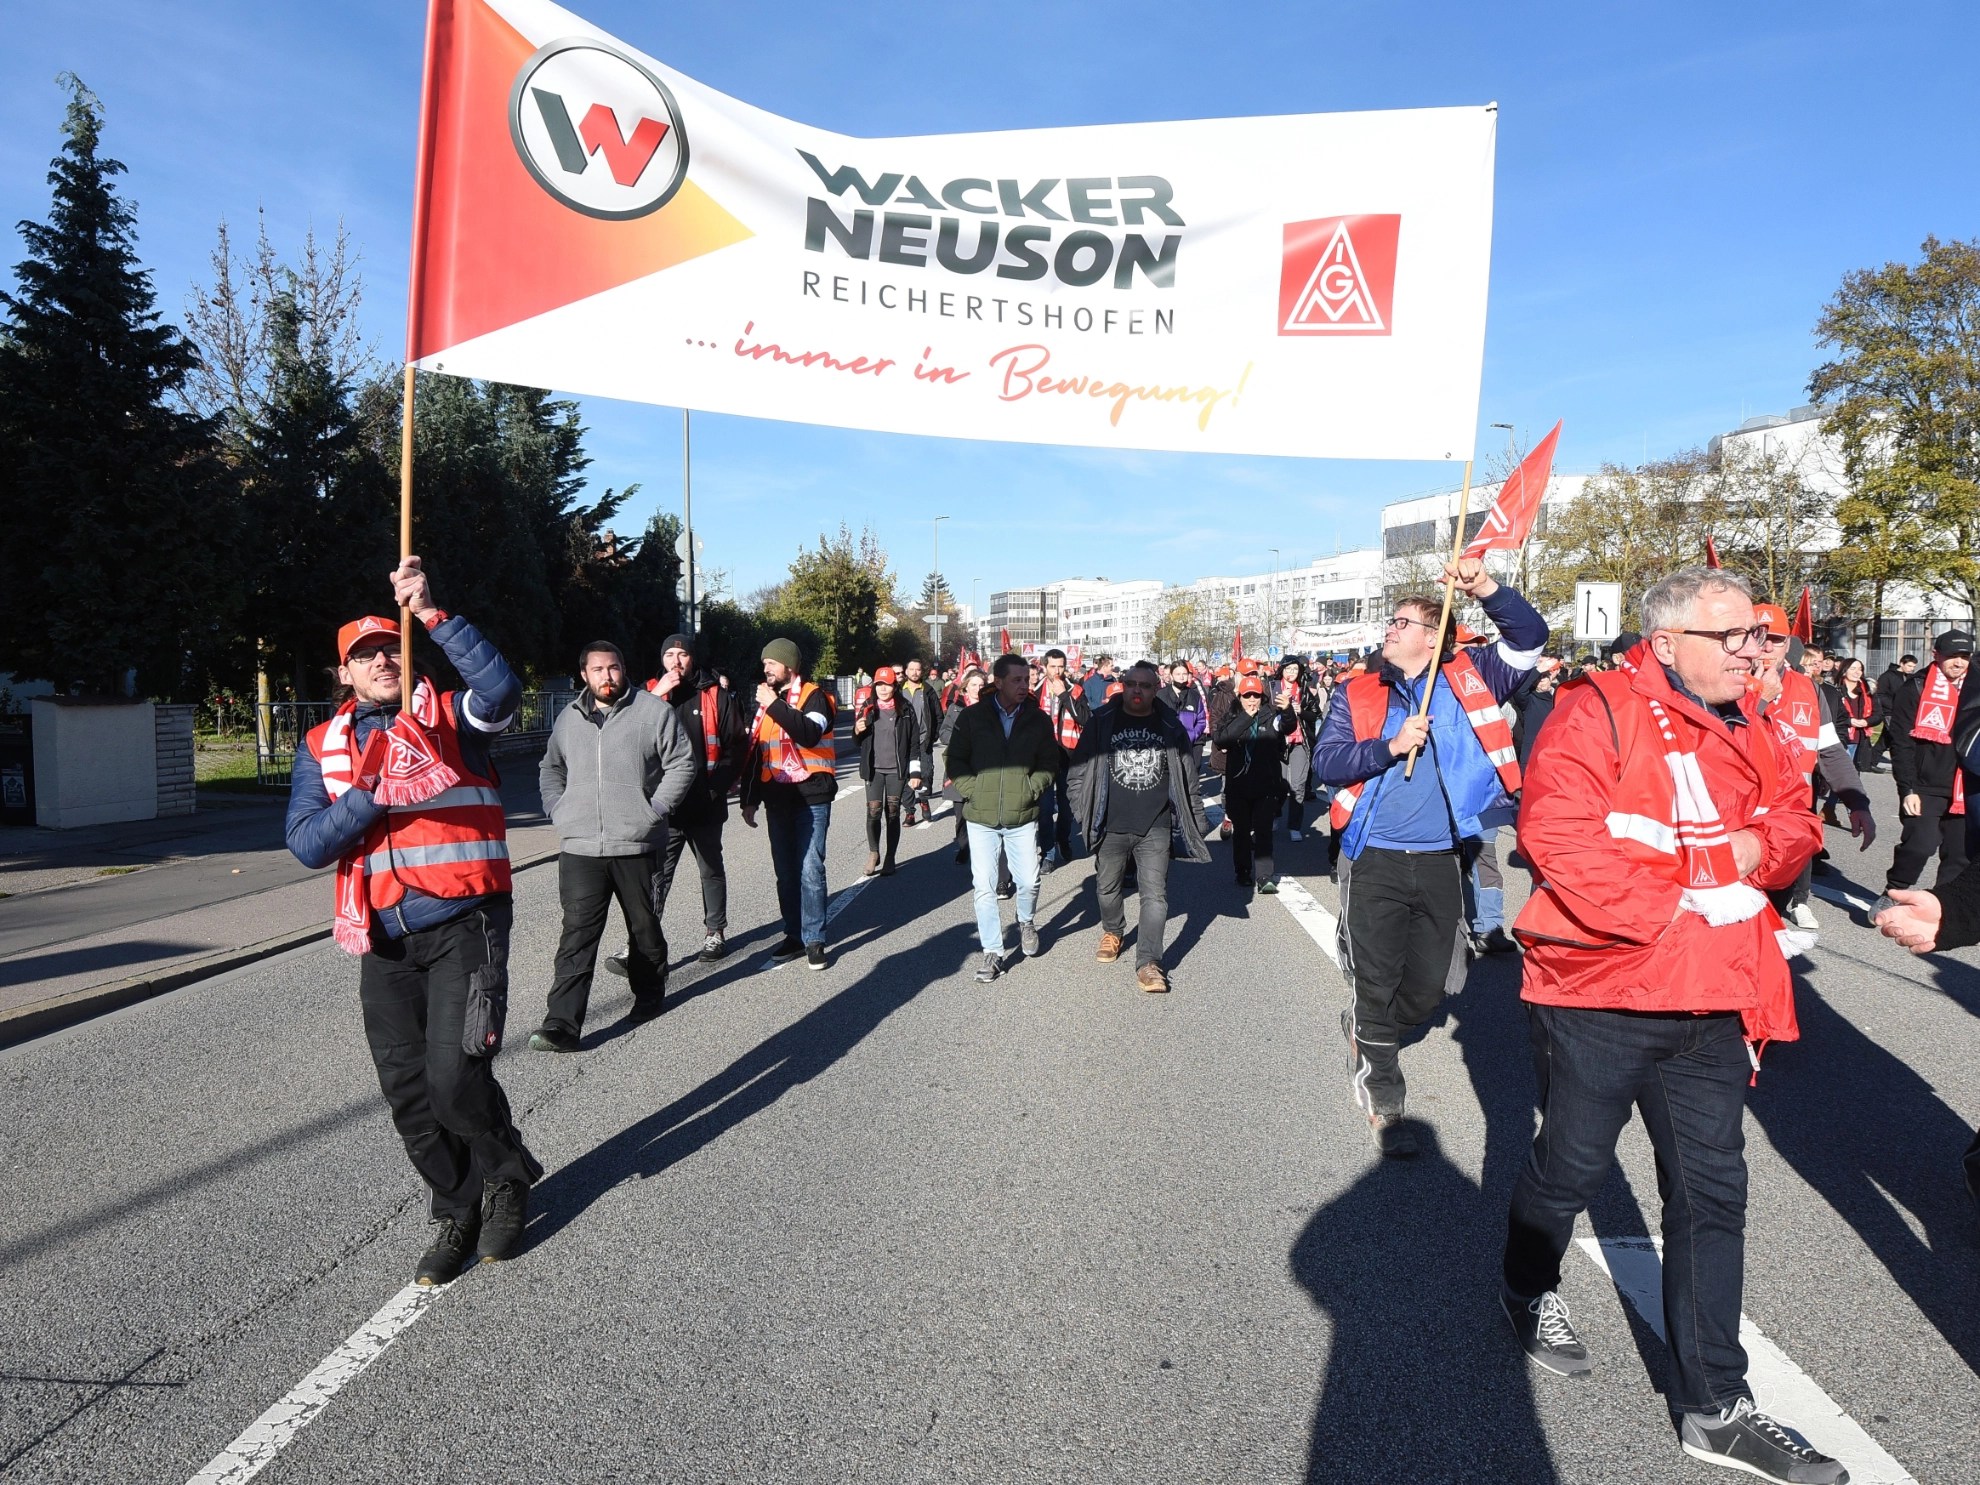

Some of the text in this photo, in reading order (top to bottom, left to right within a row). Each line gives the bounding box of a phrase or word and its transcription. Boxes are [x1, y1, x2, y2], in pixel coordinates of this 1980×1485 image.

[796, 148, 1186, 227] WACKER
[805, 197, 1182, 289] NEUSON
[803, 270, 1175, 335] REICHERTSHOFEN
[735, 321, 896, 377] immer
[914, 346, 971, 384] in
[988, 343, 1255, 432] Bewegung!
